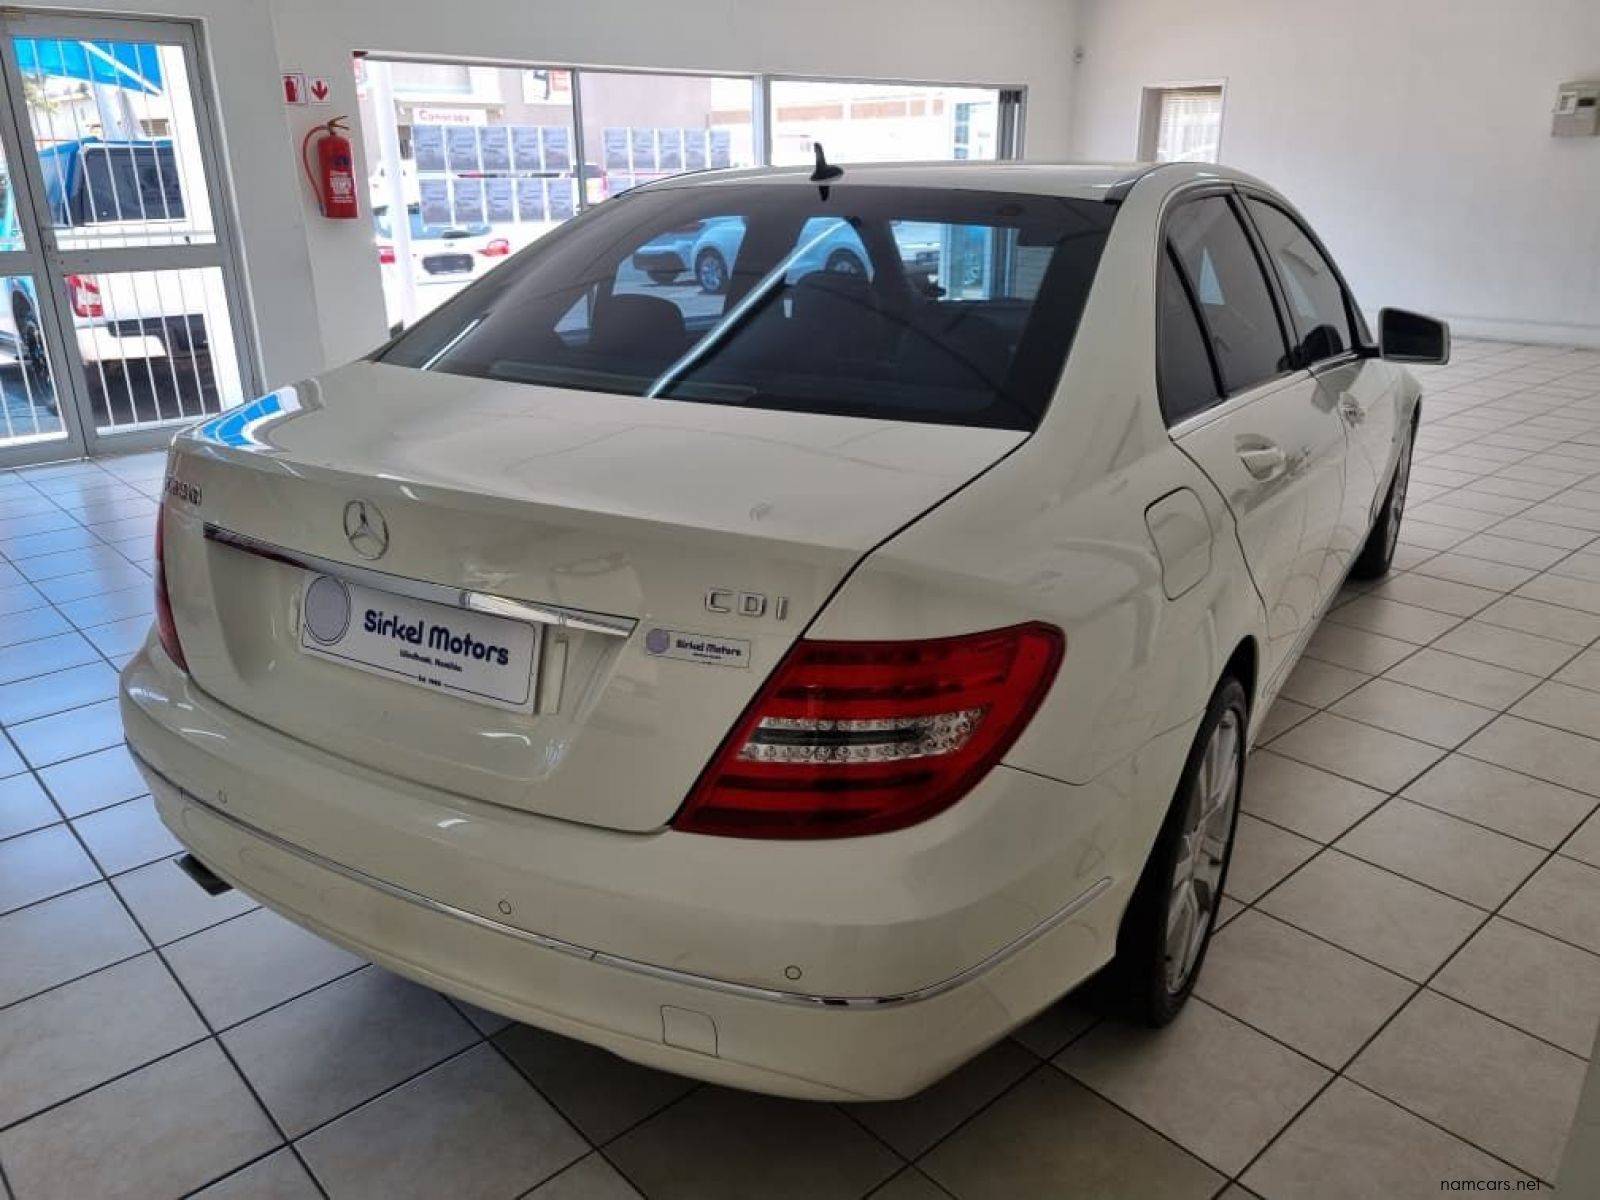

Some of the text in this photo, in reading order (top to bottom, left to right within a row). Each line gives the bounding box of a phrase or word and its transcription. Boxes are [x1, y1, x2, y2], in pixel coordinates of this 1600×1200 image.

[705, 587, 788, 621] CDI
[364, 609, 425, 645] Sirkel
[428, 625, 509, 666] Motors
